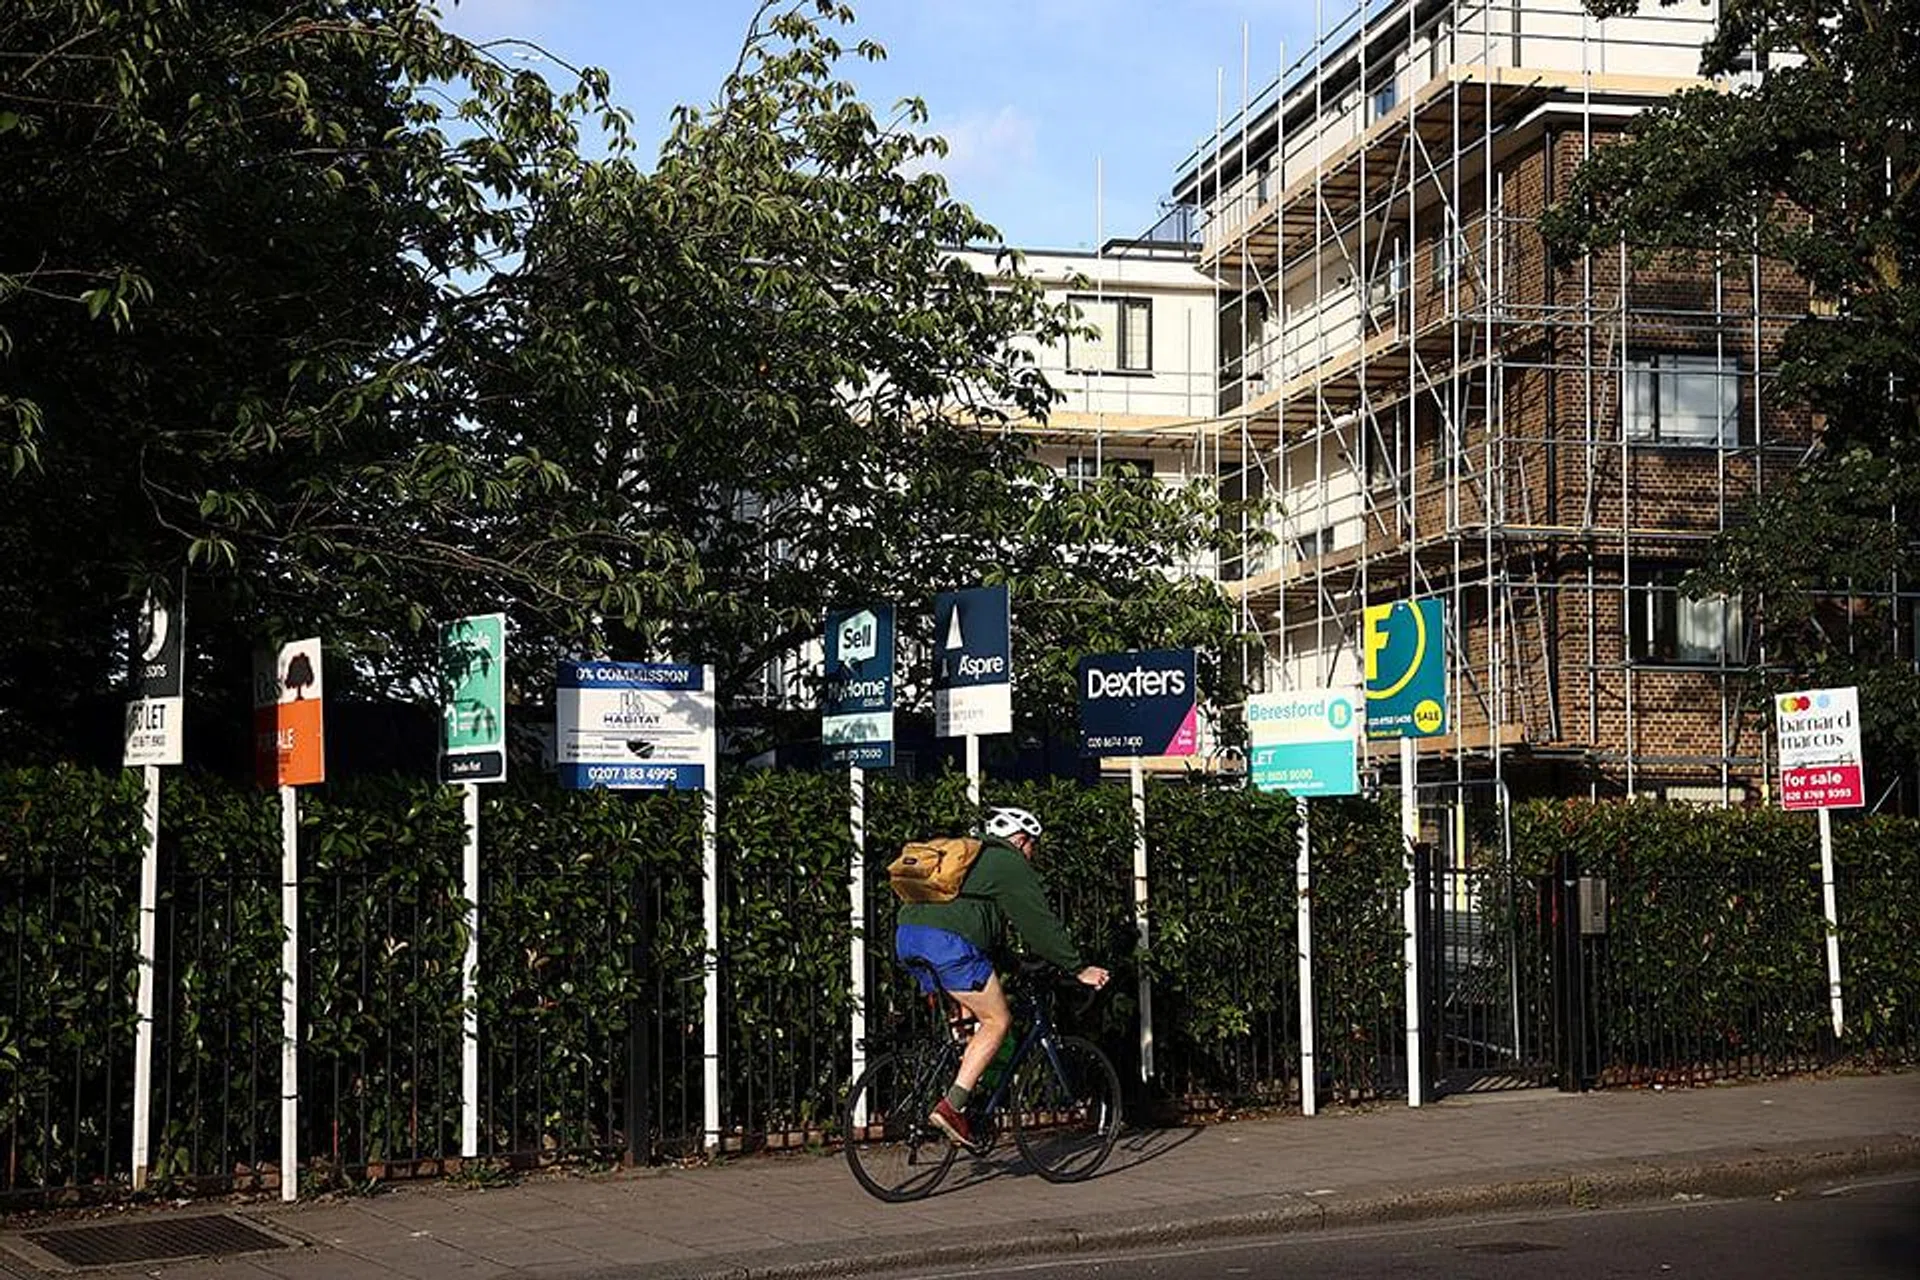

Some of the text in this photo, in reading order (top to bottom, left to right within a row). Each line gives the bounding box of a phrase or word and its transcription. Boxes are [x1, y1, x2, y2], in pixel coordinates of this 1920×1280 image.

[843, 624, 872, 650] Sell
[576, 667, 689, 683] 0% COMMISSION
[1088, 665, 1186, 699] Dexters
[146, 704, 166, 730] LET
[1250, 699, 1325, 721] Beresford
[1417, 710, 1439, 721] SALE
[1780, 709, 1850, 733] barnard
[1782, 734, 1844, 750] marcus
[588, 767, 677, 781] 0207 183 4995
[1784, 770, 1843, 787] for sale
